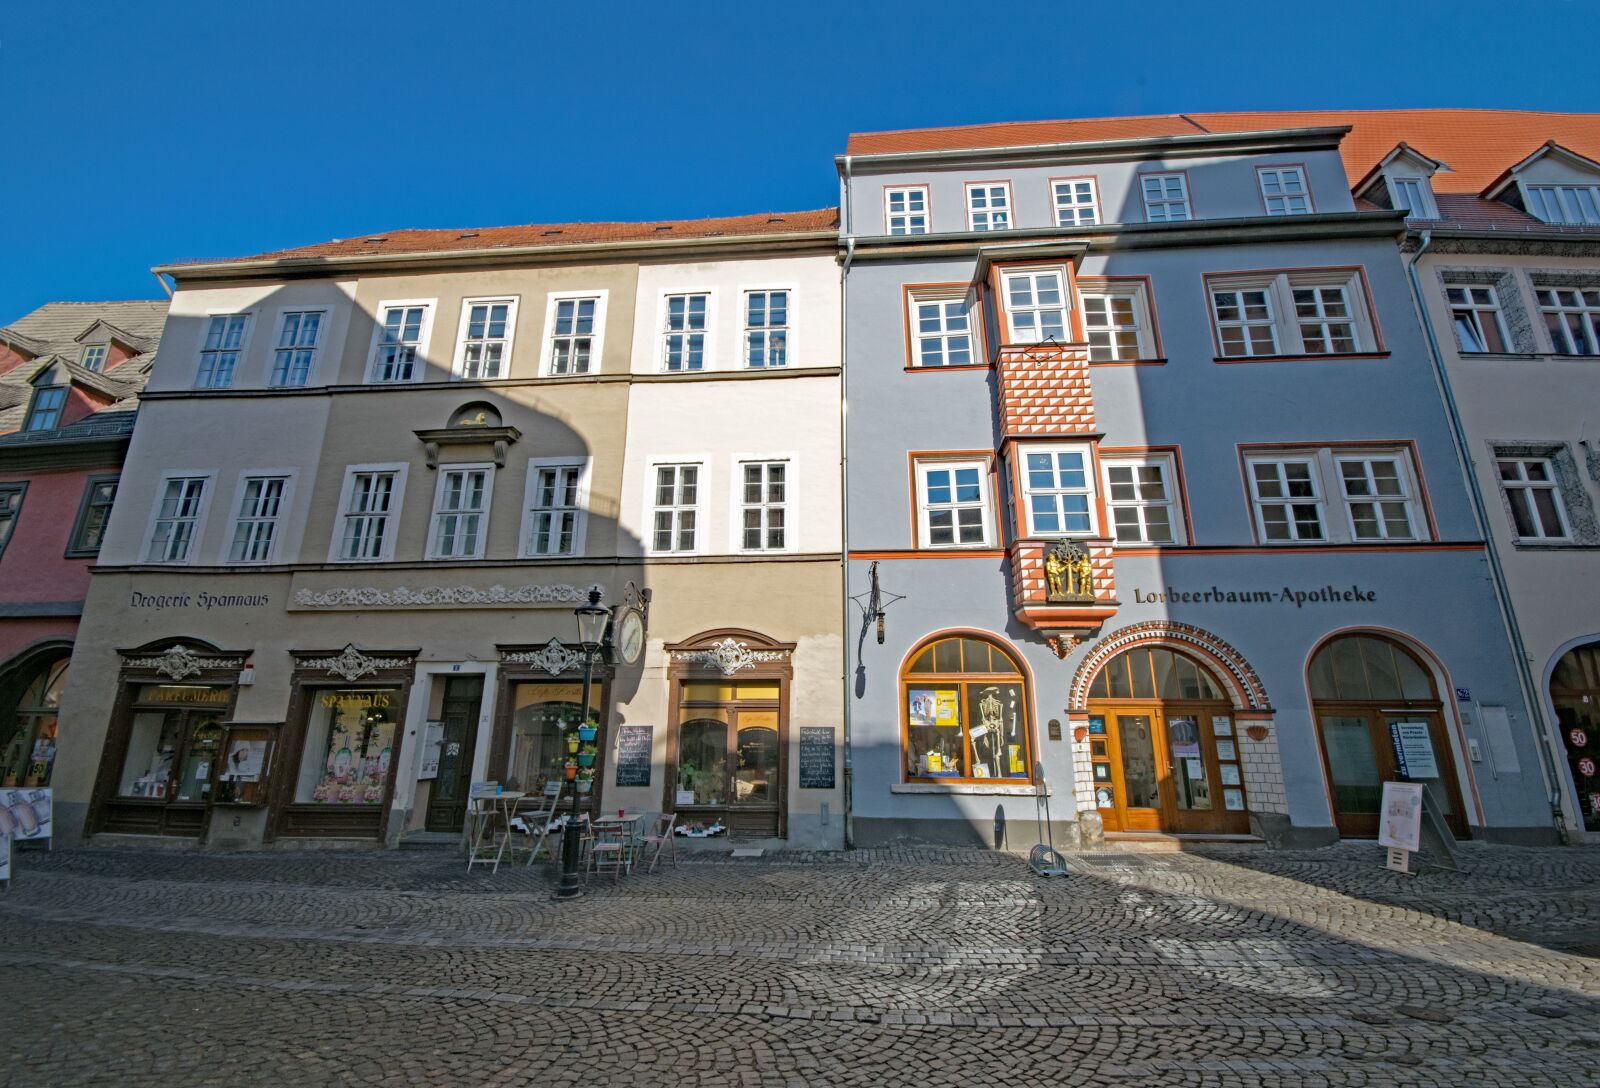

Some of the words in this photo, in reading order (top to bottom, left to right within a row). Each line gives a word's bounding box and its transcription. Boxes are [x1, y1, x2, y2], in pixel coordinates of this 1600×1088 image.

[131, 592, 191, 610] Drogerie
[197, 592, 269, 610] Spannaus
[1134, 585, 1378, 608] Lorbeerbaum-Apotheke
[321, 694, 391, 708] SPANNAUS
[1391, 724, 1405, 765] vermieten
[1571, 732, 1586, 745] 50
[1579, 761, 1595, 774] 30
